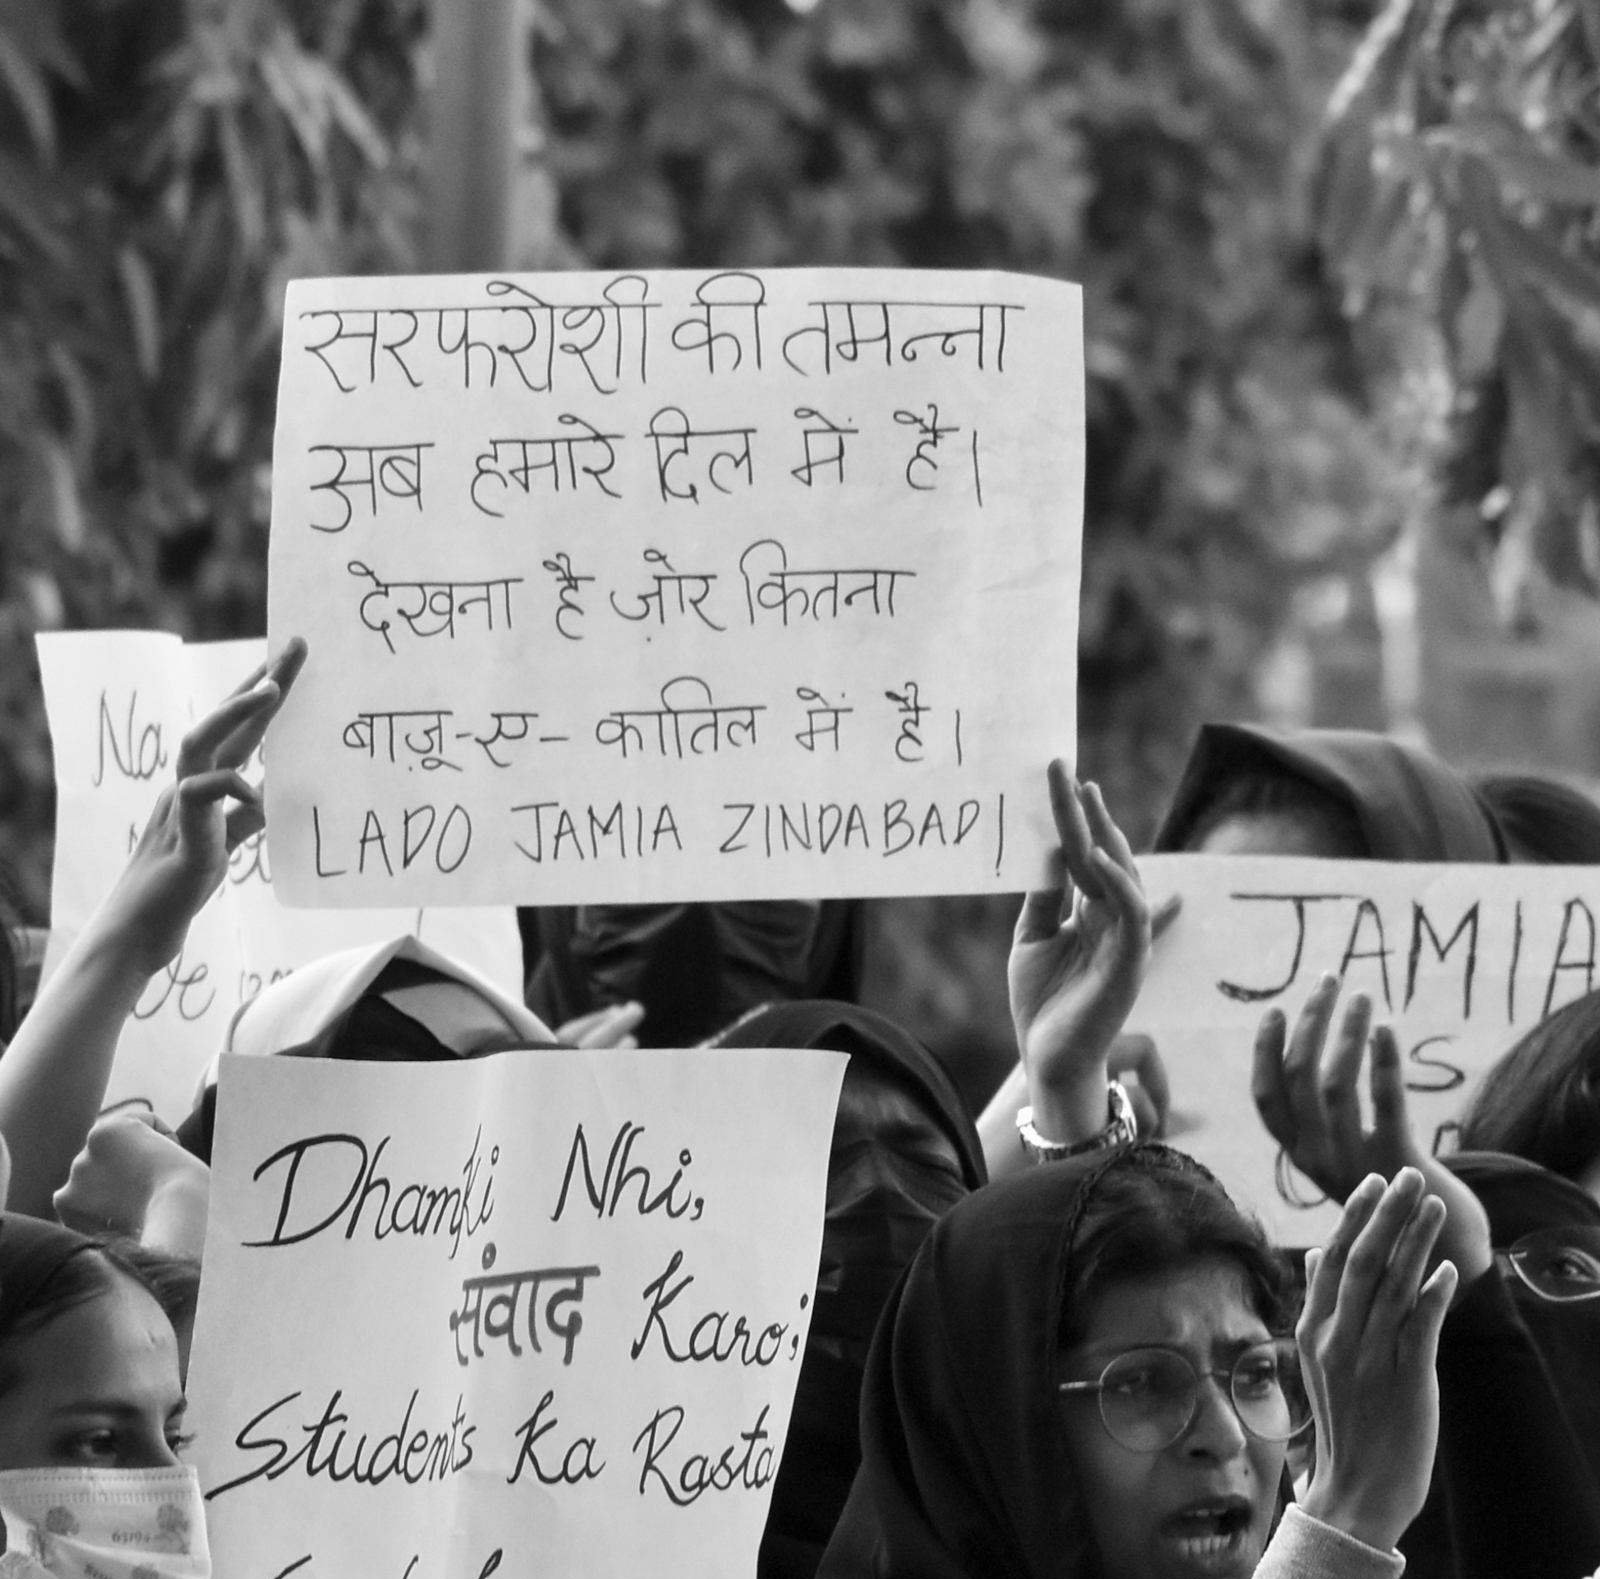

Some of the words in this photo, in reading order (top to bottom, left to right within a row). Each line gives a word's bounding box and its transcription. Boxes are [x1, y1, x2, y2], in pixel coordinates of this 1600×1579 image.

[299, 274, 663, 393] सरफरोशी
[671, 270, 767, 373] की
[782, 300, 1025, 376] तमन्ना
[308, 442, 435, 534] अब
[470, 413, 626, 518] हमारे
[644, 406, 758, 505] दिल
[790, 407, 859, 487] में
[347, 560, 524, 654] देखना
[542, 552, 596, 641] है
[739, 538, 917, 627] कितना
[92, 690, 168, 787] Na
[595, 675, 767, 760] कातिल
[795, 686, 854, 752] में
[313, 804, 472, 878] LADO
[510, 800, 682, 864] JAMIA
[1216, 891, 1597, 1024] JAMIA
[240, 1124, 500, 1260] Dhamki
[550, 1120, 704, 1223] Nhi,
[448, 1238, 601, 1367] संवाद
[202, 1388, 477, 1502] Students
[506, 1389, 606, 1486] Ka
[632, 1403, 776, 1507] Rasta
